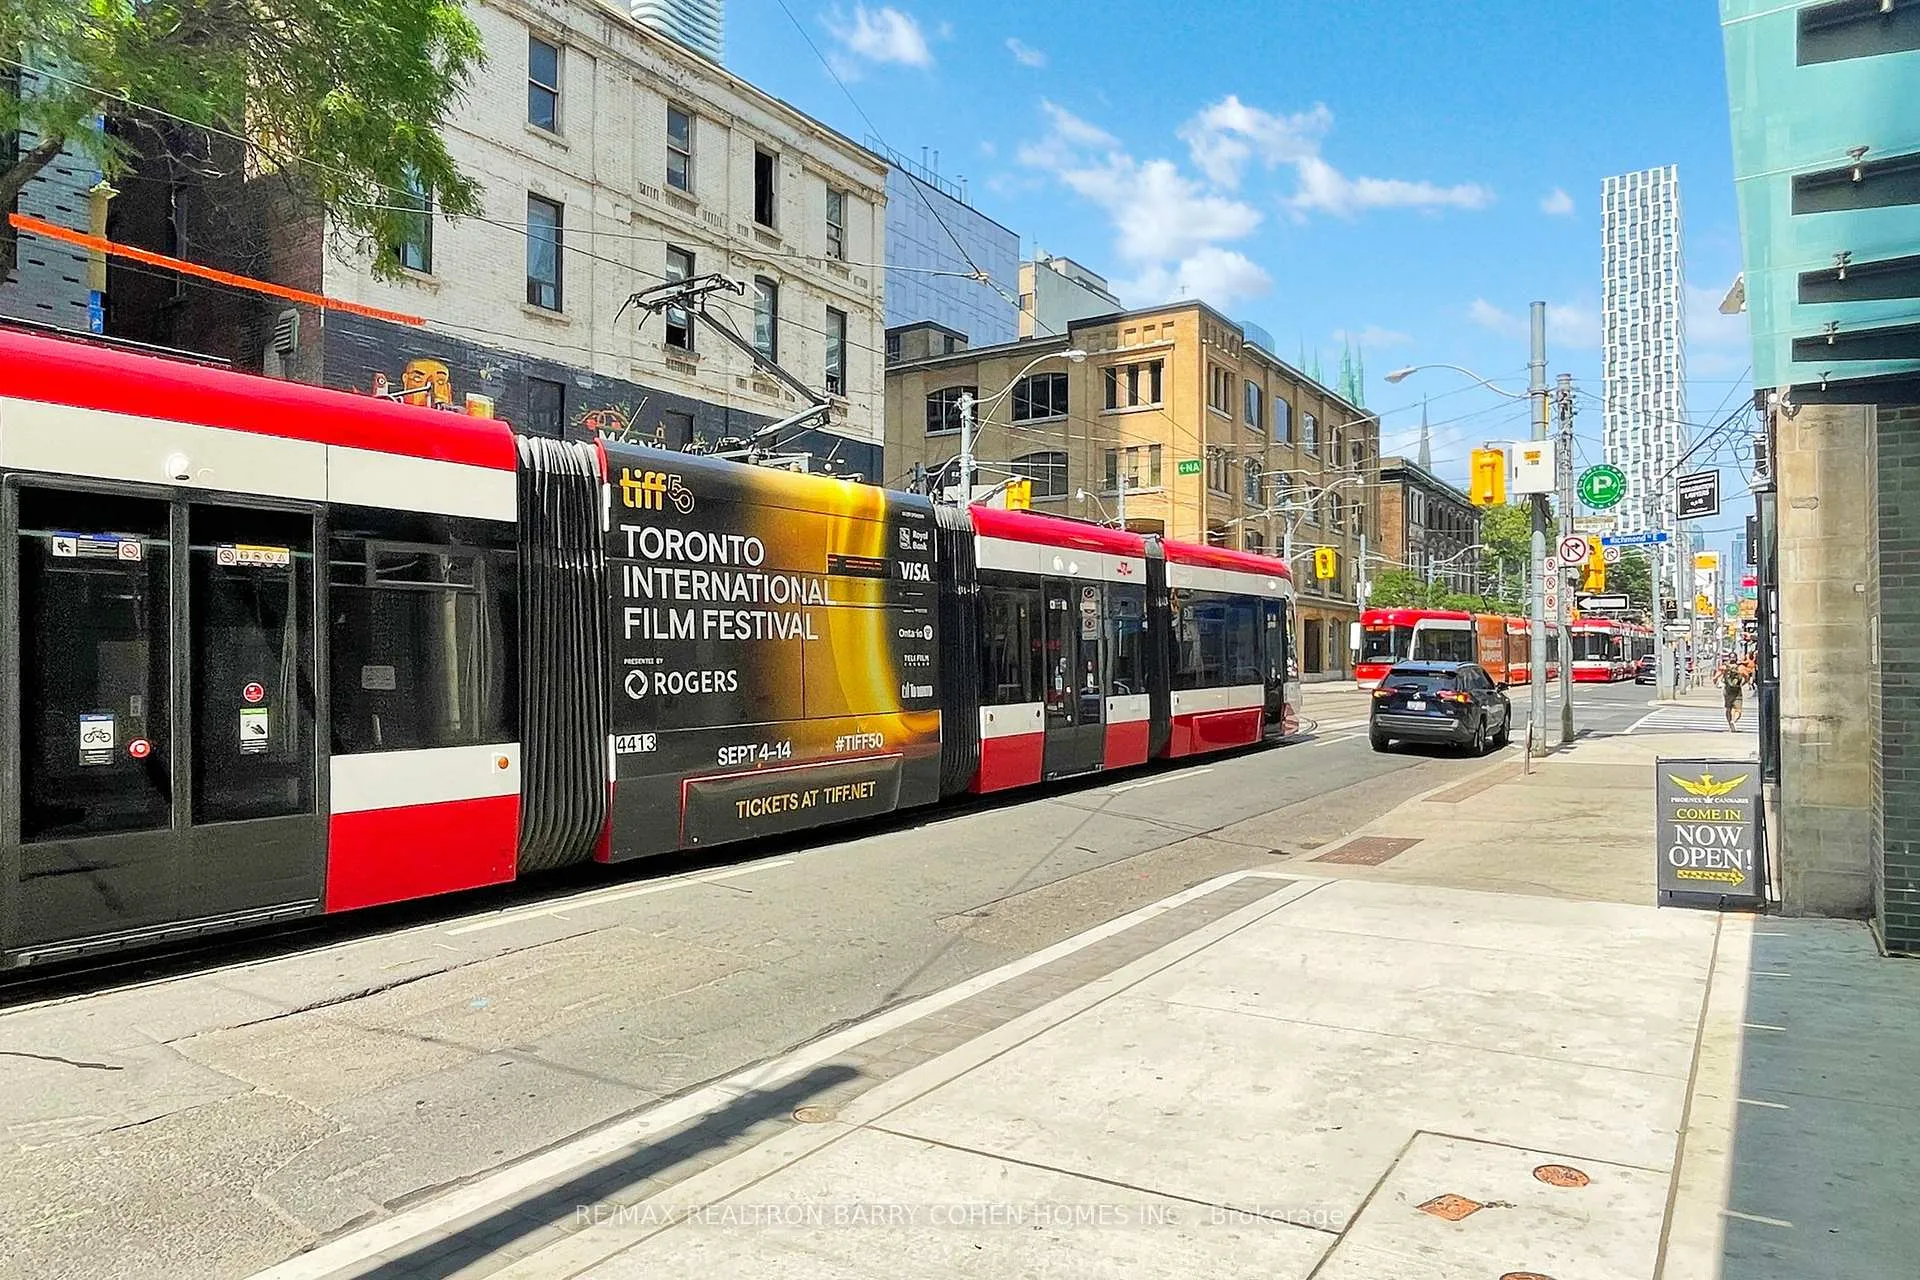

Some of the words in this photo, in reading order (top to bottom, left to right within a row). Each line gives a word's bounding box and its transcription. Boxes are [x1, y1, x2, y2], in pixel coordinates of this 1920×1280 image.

[620, 467, 667, 511] tiff
[1592, 475, 1613, 495] P
[620, 524, 766, 567] TORONTO
[1609, 532, 1646, 545] Richmond
[898, 561, 931, 582] VISA
[623, 565, 838, 606] INTERNATIONAL
[624, 607, 695, 640] FILM
[702, 609, 819, 641] FESTIVAL
[654, 669, 738, 695] ROGERS
[617, 734, 656, 753] 4413
[835, 732, 885, 753] #TIFF50
[717, 744, 758, 767] SEPT
[735, 792, 799, 819] TICKETS
[801, 789, 820, 809] AT
[824, 781, 876, 805] TIFF.NET
[1676, 808, 1721, 820] COME
[1724, 809, 1741, 820] IN
[1674, 824, 1744, 847] NOW
[1668, 845, 1753, 871] OPEN!
